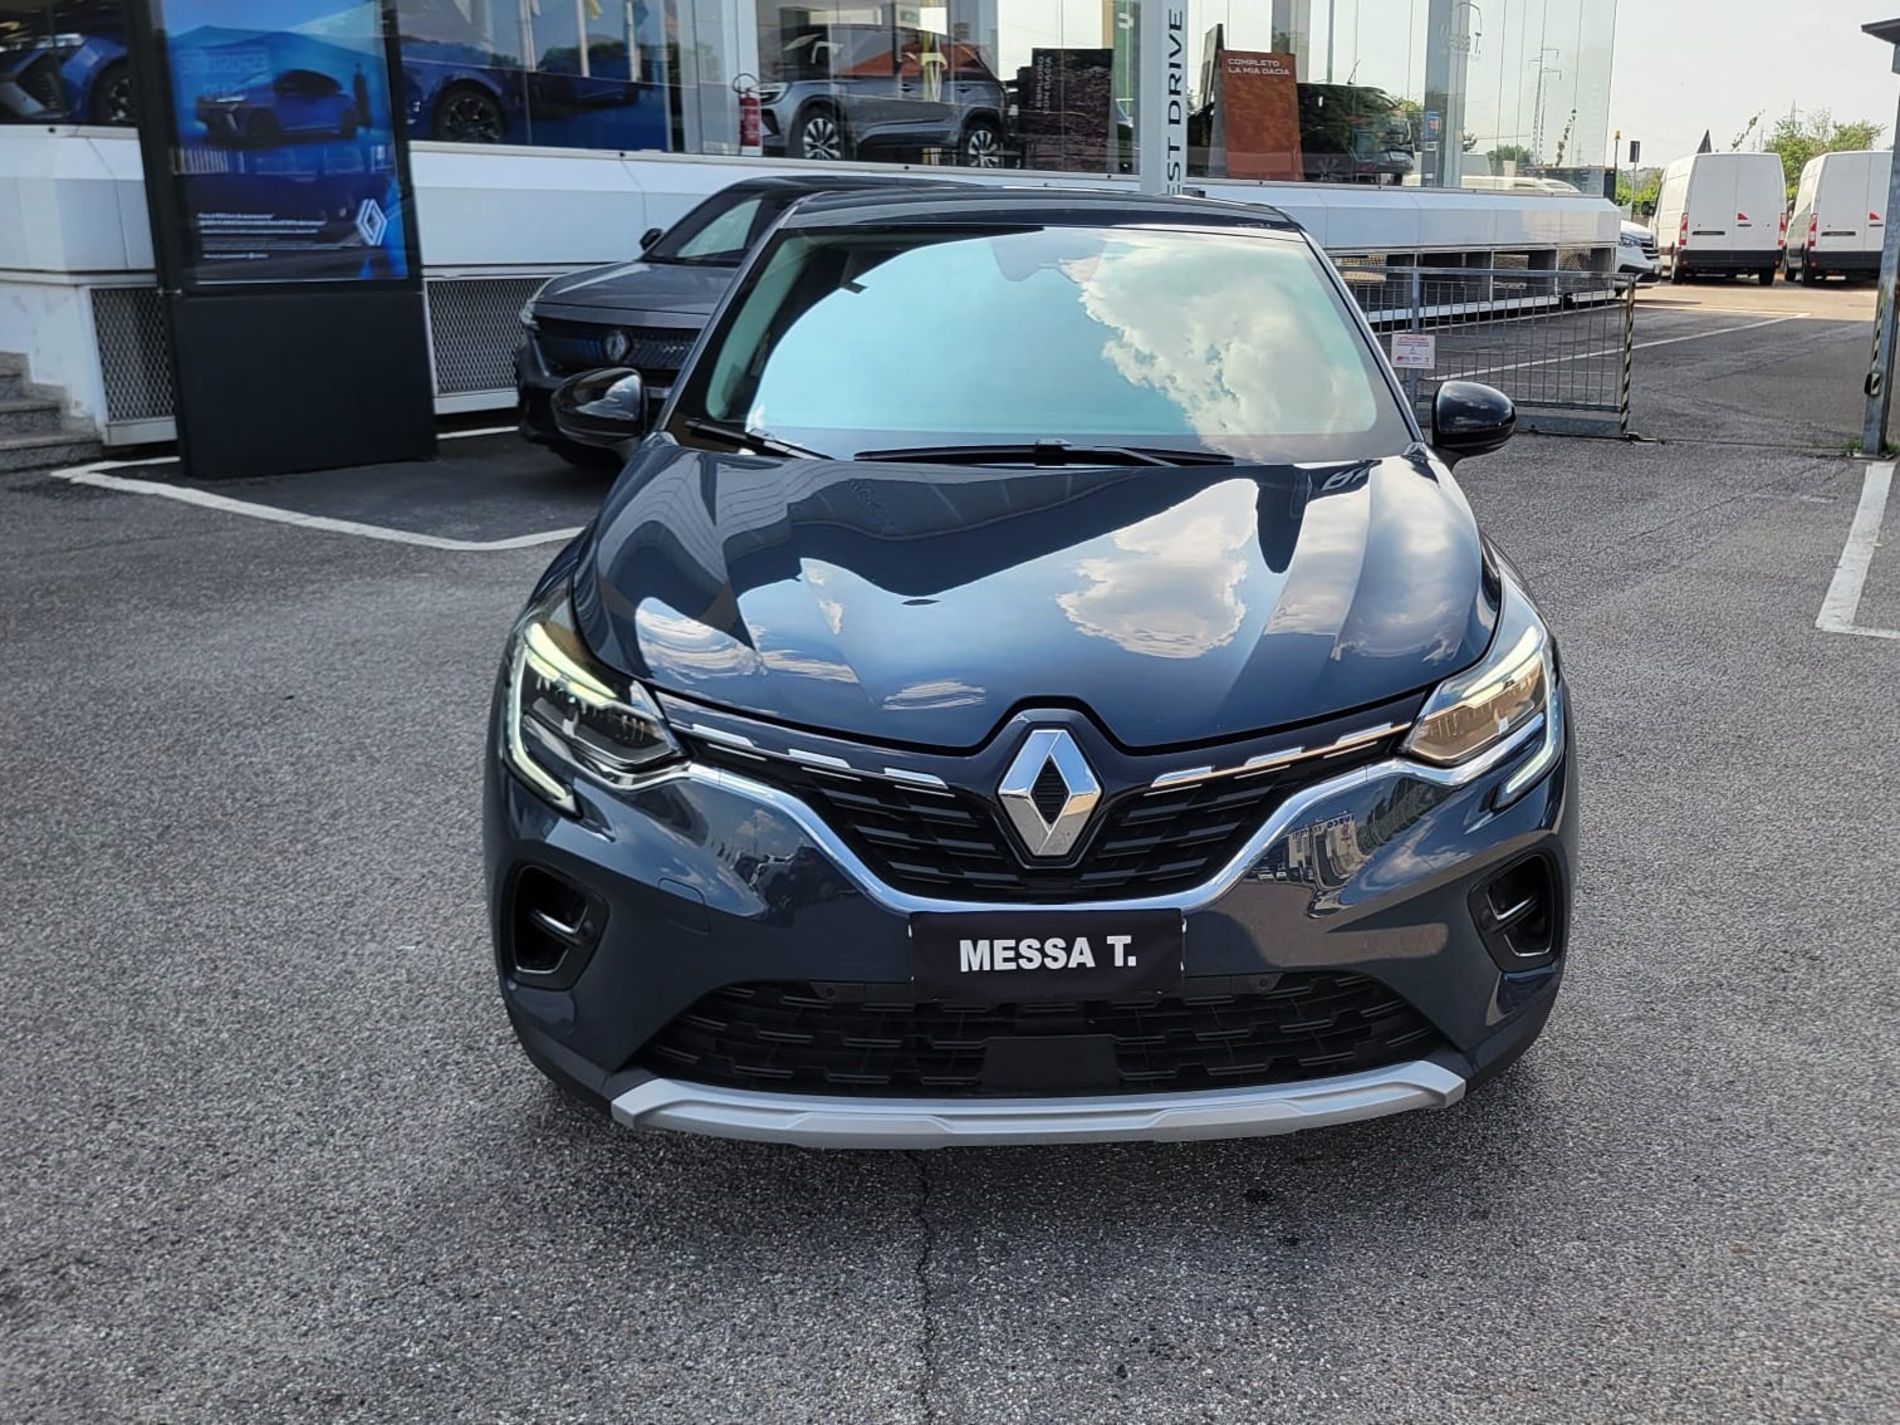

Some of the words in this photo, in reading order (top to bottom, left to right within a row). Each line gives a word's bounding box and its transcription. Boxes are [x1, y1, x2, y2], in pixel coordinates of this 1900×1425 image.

[1168, 9, 1183, 126] DRIVE
[1227, 58, 1280, 67] COMPLETO
[1227, 66, 1242, 74] LA
[1243, 67, 1261, 75] MIA
[1262, 68, 1290, 76] DACIA
[959, 936, 1096, 972] MESSA
[1106, 935, 1137, 967] T.
